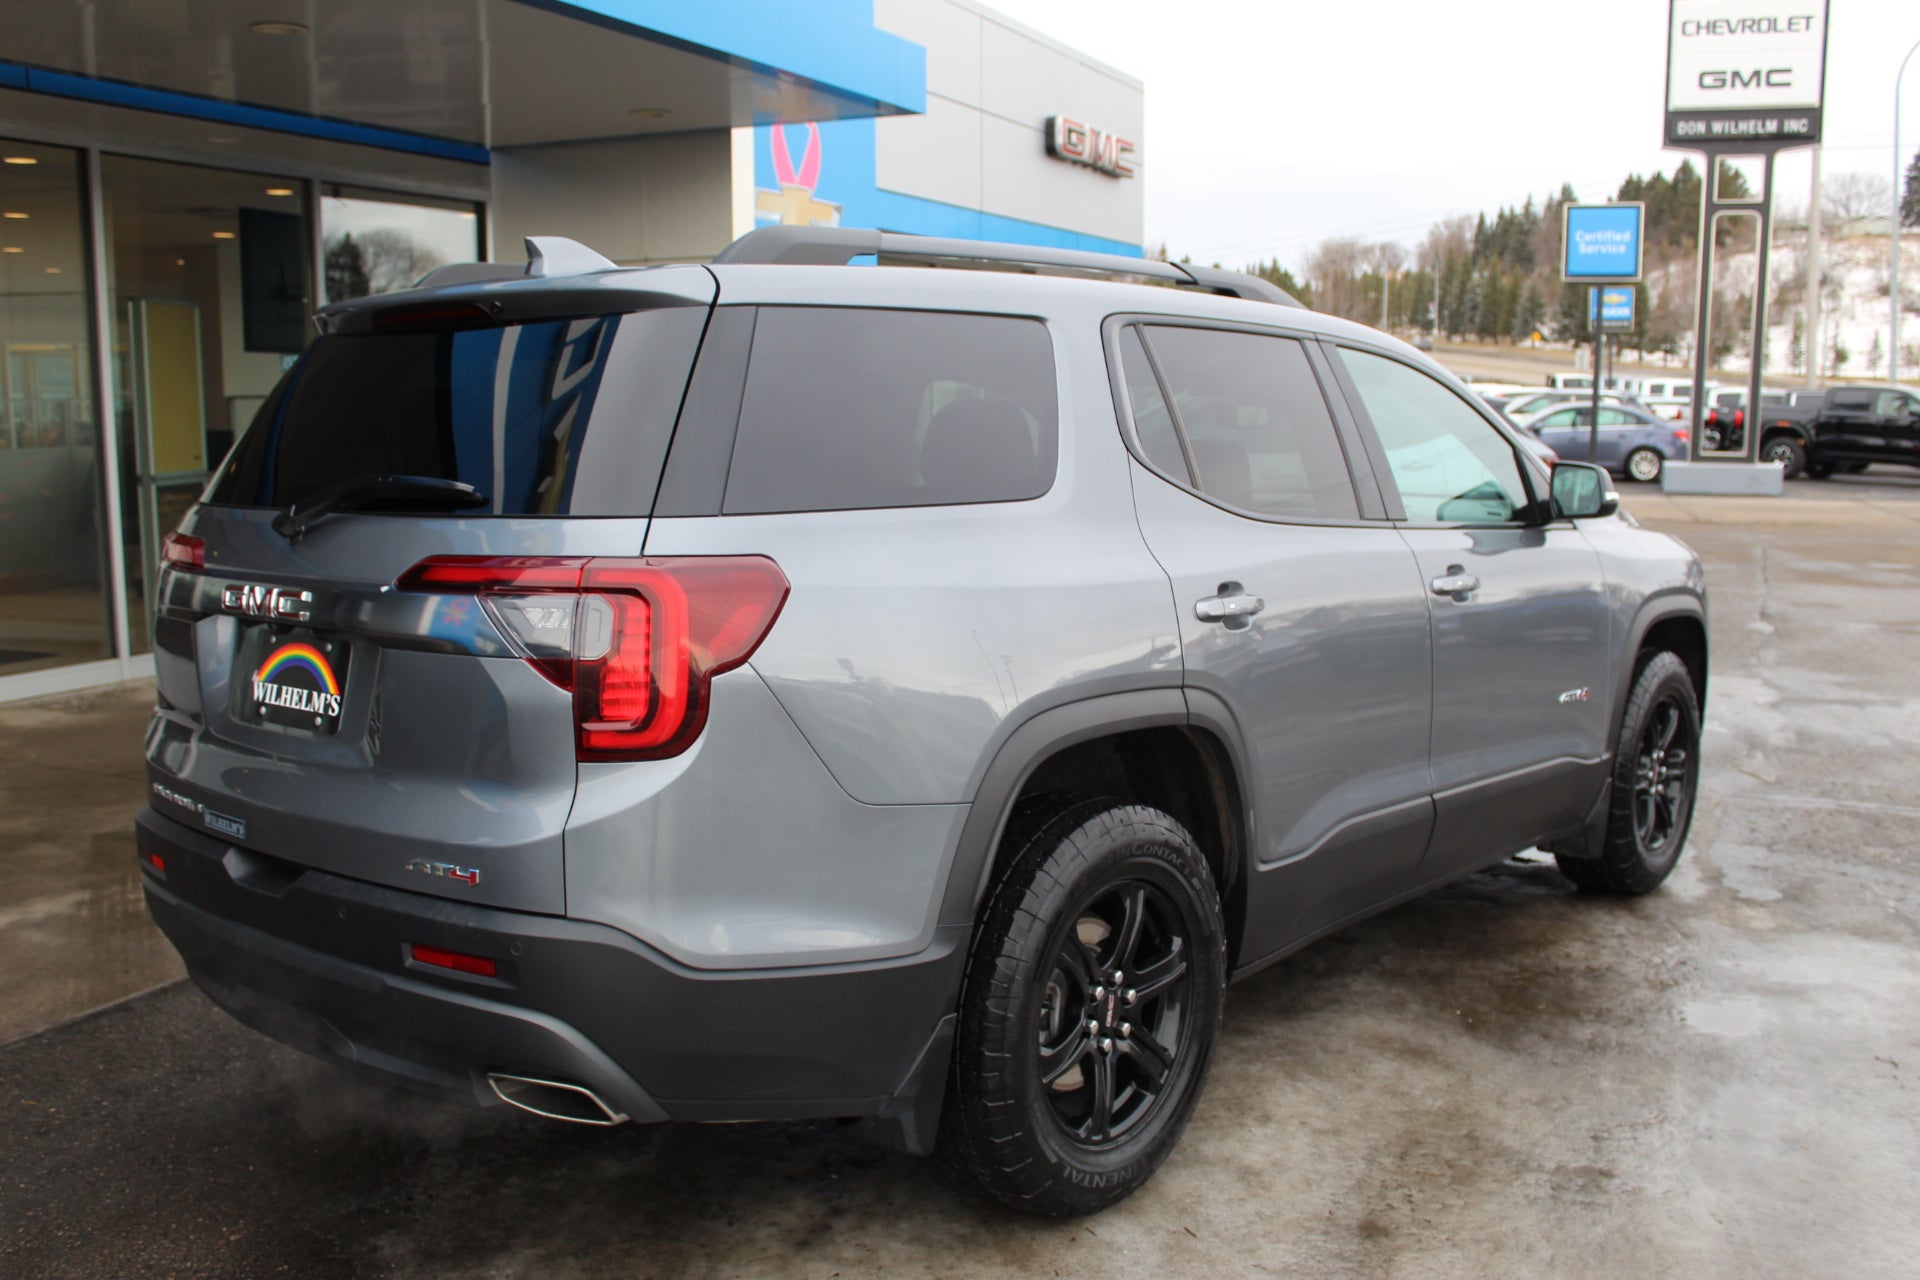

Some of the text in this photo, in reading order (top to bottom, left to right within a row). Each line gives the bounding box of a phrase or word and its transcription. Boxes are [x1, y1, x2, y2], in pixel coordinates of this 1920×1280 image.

[1682, 16, 1814, 36] CHEVROLET
[1699, 69, 1792, 89] GMC
[1677, 118, 1809, 135] DON WILHELM INC
[1057, 116, 1136, 177] GMC
[1576, 230, 1631, 242] Certified
[1578, 243, 1627, 254] Service
[222, 584, 313, 621] GMC
[253, 680, 341, 717] WILHELM'S
[404, 860, 480, 886] AT4
